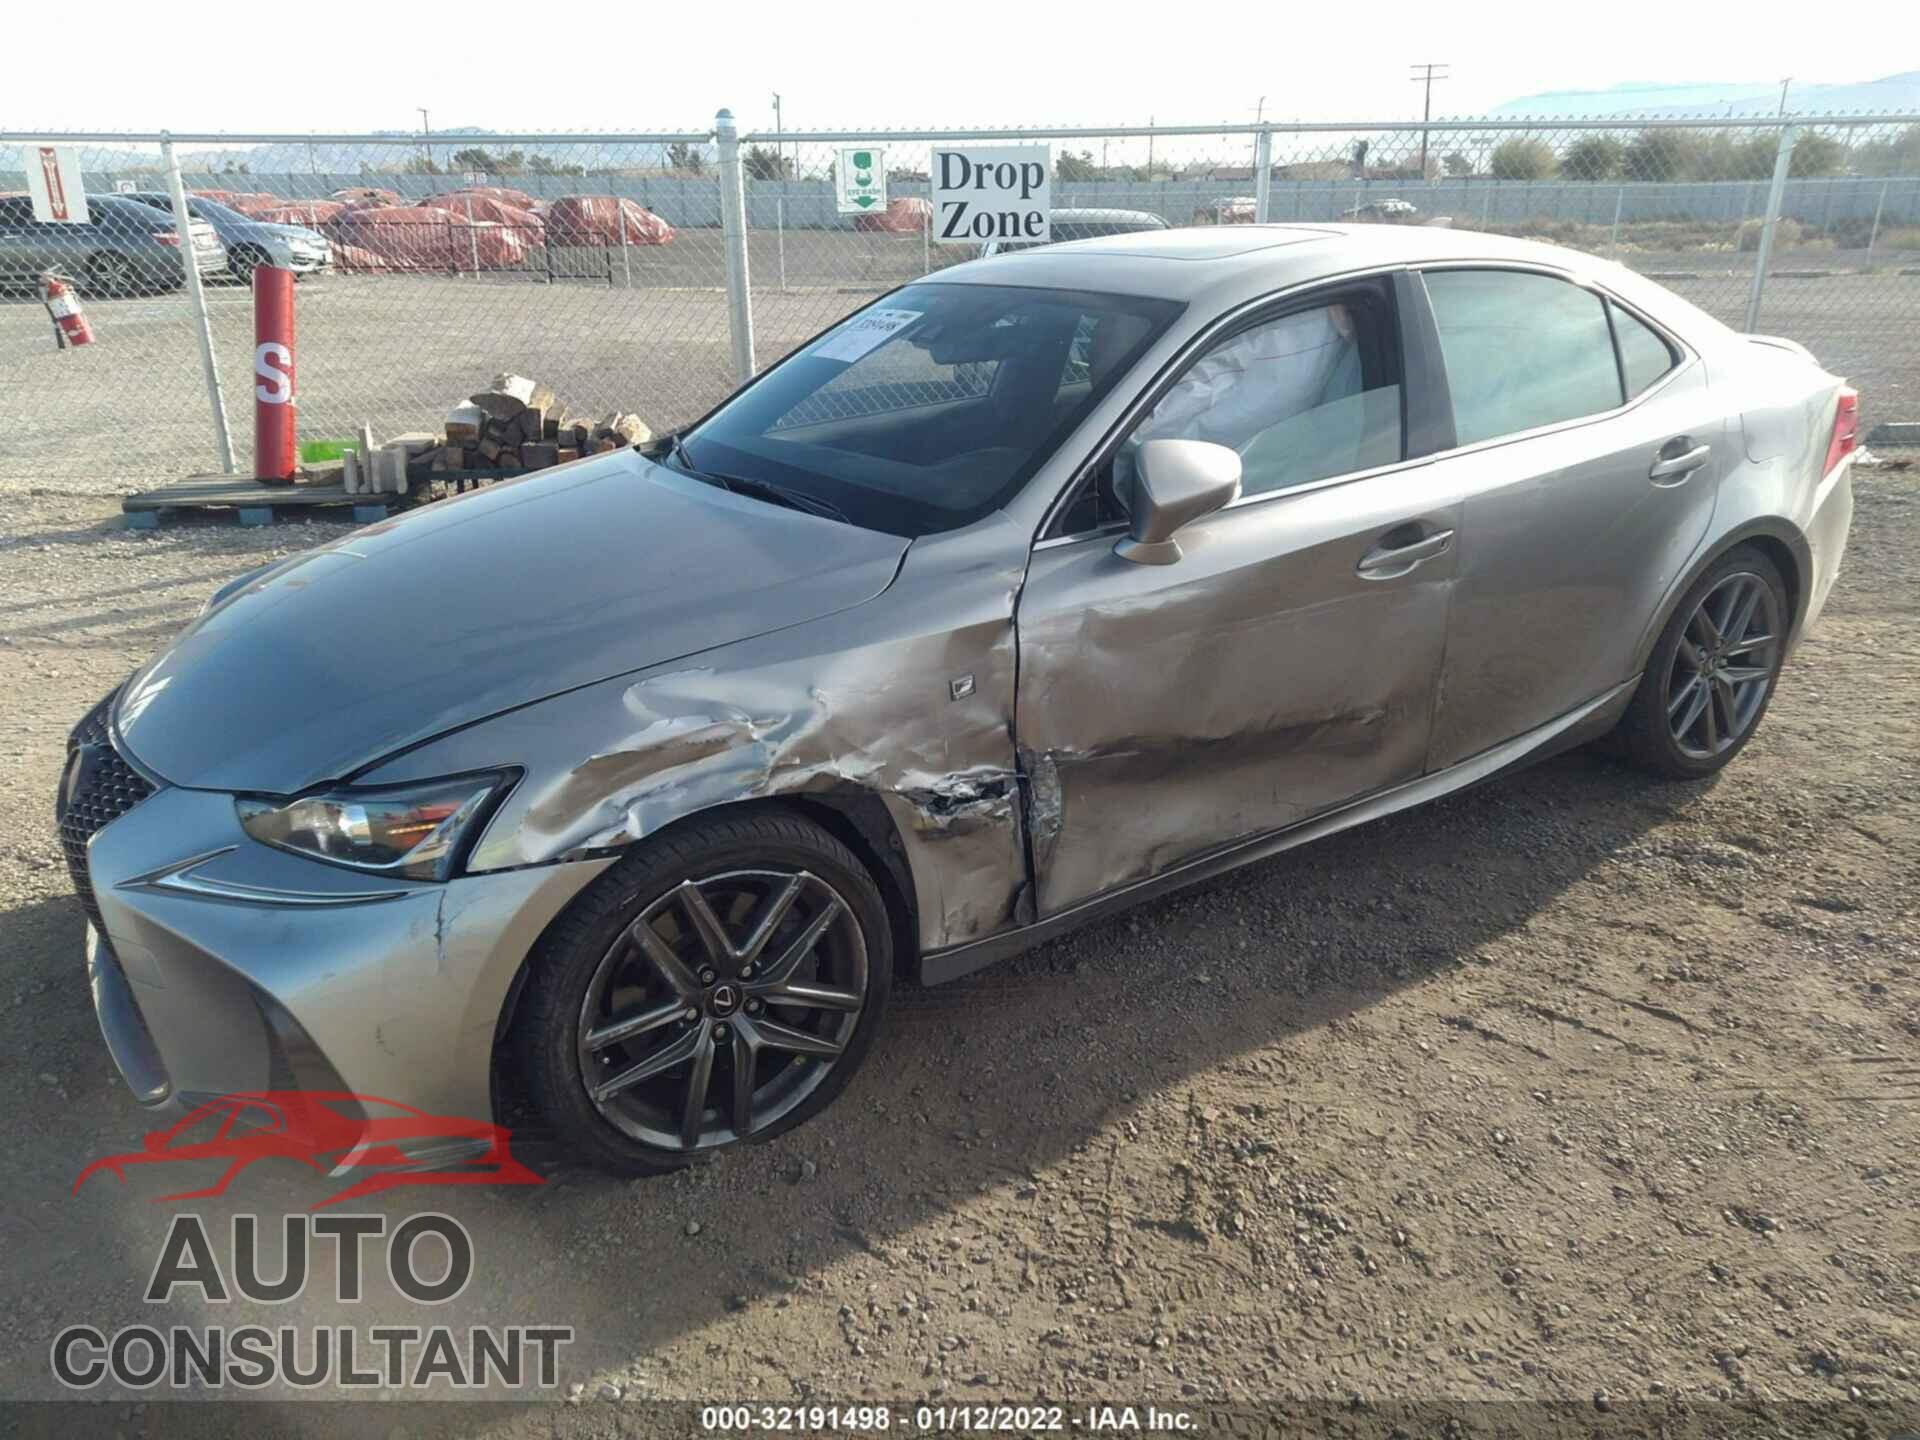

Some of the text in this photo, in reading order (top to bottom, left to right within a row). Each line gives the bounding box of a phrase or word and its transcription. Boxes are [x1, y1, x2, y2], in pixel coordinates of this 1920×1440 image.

[937, 152, 1044, 199] Drop
[941, 201, 1044, 238] Zone
[255, 342, 292, 404] S
